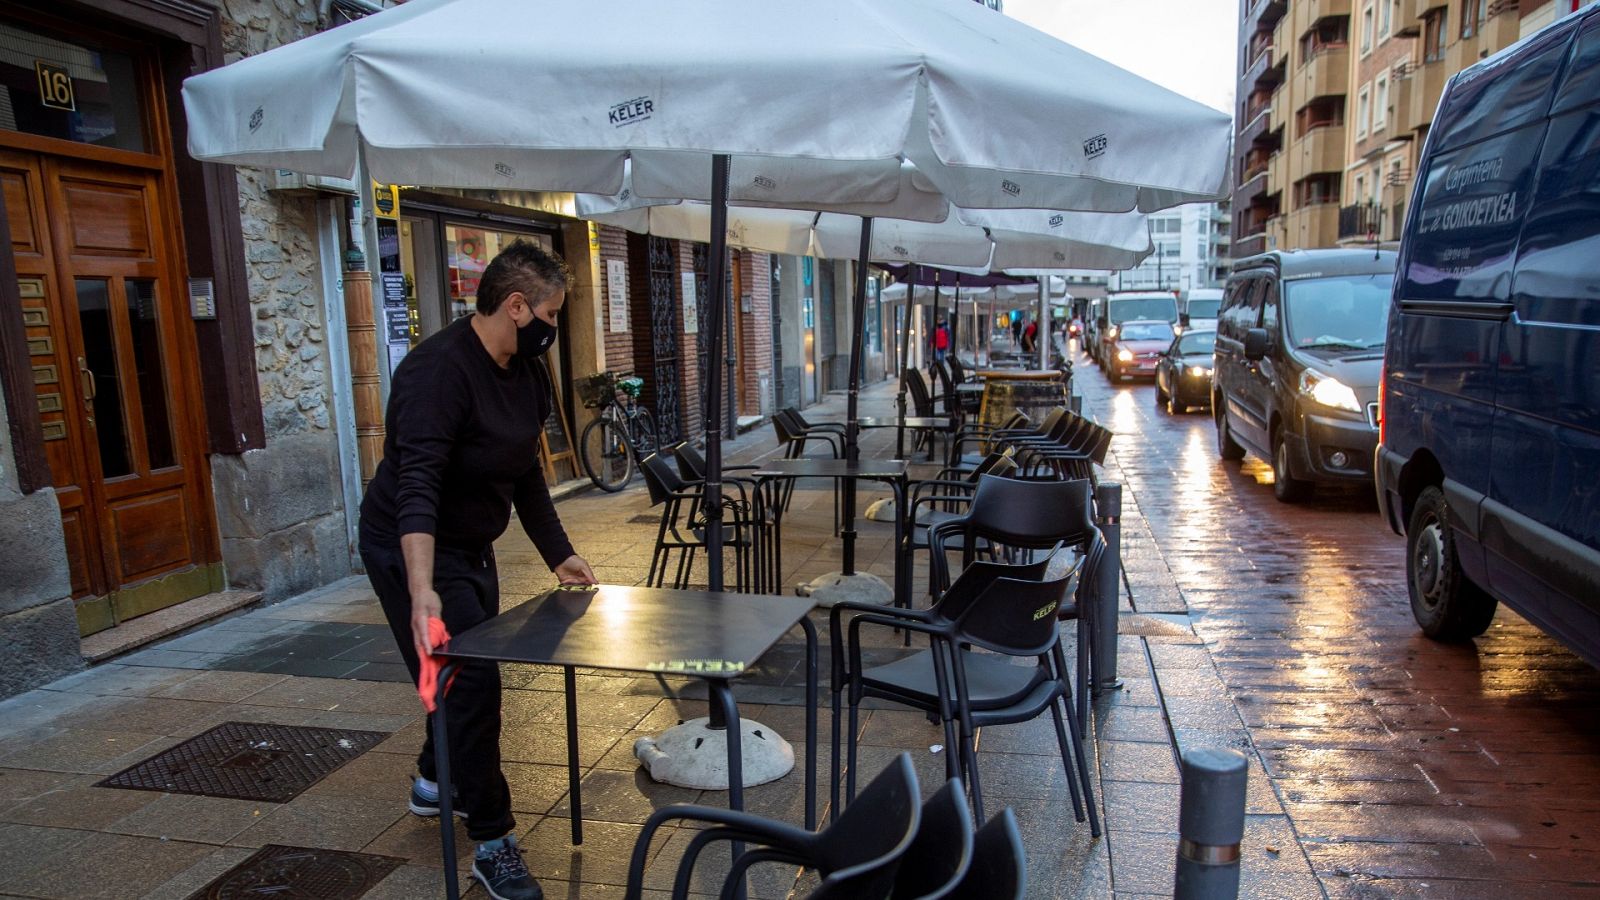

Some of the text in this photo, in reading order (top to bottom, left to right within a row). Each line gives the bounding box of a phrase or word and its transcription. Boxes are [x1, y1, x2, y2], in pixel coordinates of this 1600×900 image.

[41, 69, 70, 104] 16
[608, 100, 654, 124] KELER
[1083, 137, 1107, 156] KELER
[1442, 191, 1517, 231] GOIKOETXEA
[1034, 601, 1057, 620] KELER
